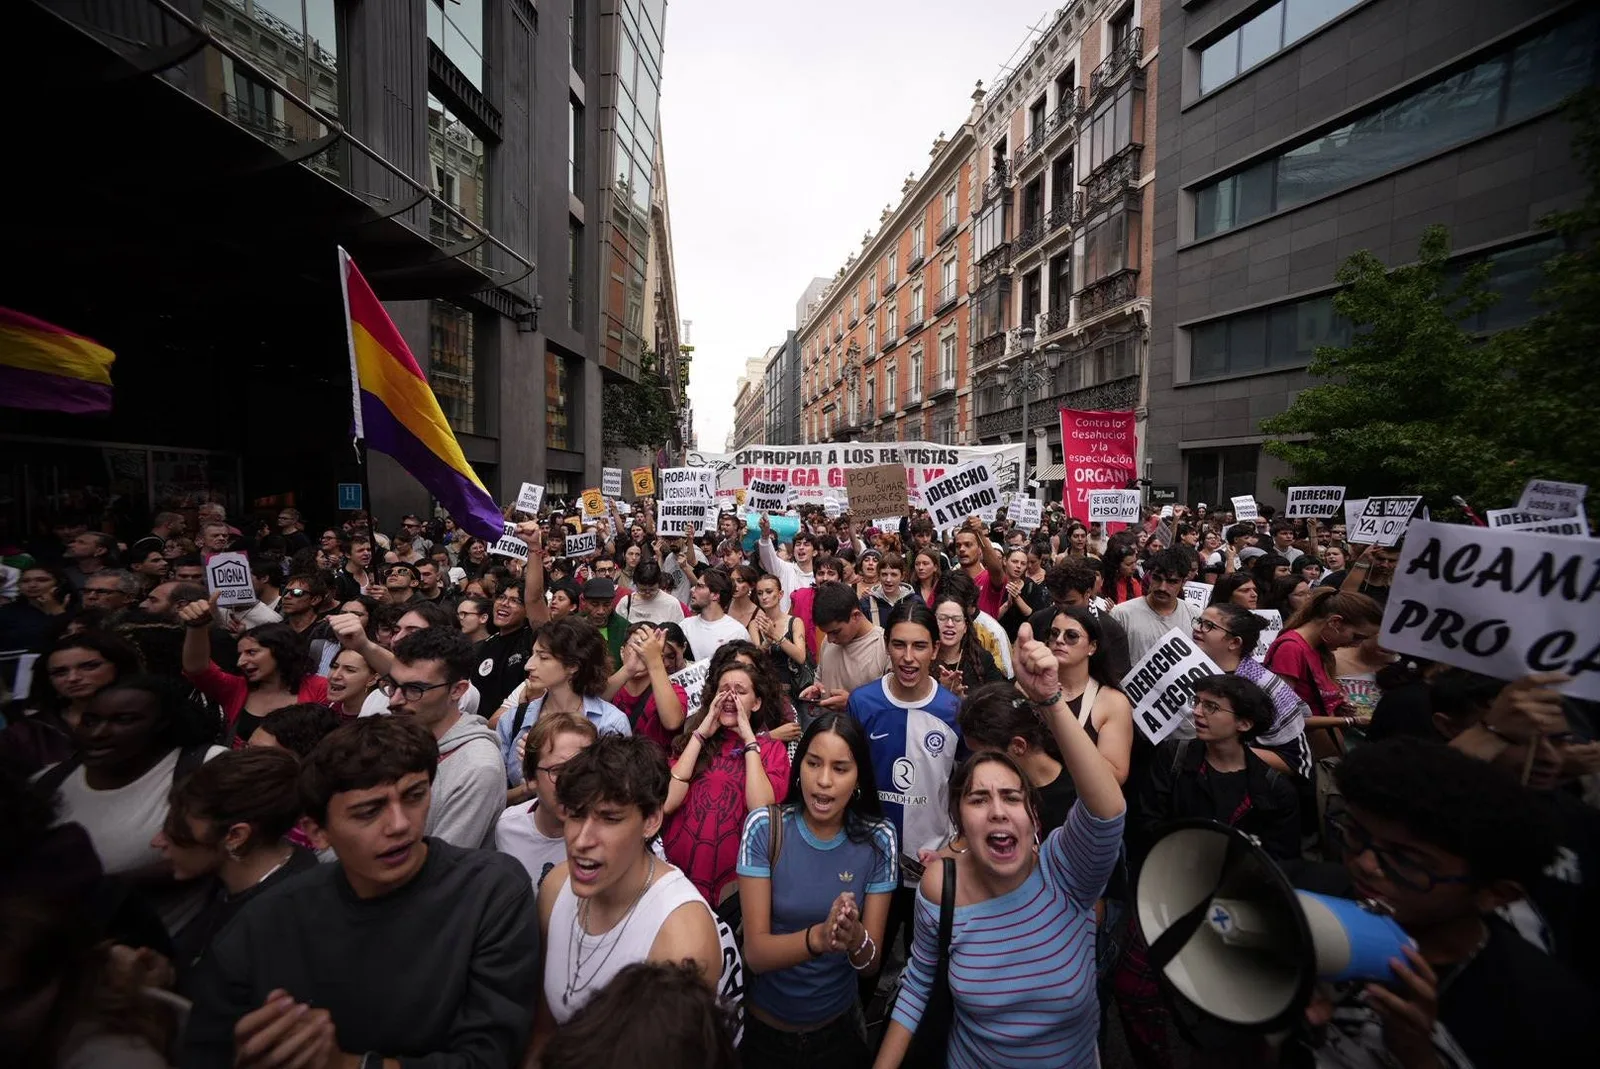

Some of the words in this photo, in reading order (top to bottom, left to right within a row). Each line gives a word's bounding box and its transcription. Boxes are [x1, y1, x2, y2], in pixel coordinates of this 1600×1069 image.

[1076, 418, 1110, 428] Contra
[1112, 419, 1127, 428] los
[1072, 430, 1126, 440] desahucios
[1091, 443, 1097, 452] y
[1099, 442, 1108, 451] la
[736, 450, 822, 465] EXPROPIAR
[828, 450, 837, 464] A
[844, 449, 874, 464] LOS
[1069, 454, 1133, 465] especulación
[664, 472, 697, 483] ROBAN
[1074, 468, 1129, 482] ORGANI
[875, 481, 904, 493] SUMAR
[924, 465, 989, 506] ¡DERECHO
[669, 487, 697, 498] CENSURAN
[1291, 490, 1342, 501] ¡DERECHO
[851, 493, 902, 504] TRAIDORES
[1093, 496, 1101, 504] SE
[1101, 496, 1119, 504] VENDE
[662, 506, 705, 516] ¡DERECHO
[935, 508, 949, 525] A
[945, 487, 998, 519] TECHO!
[1121, 507, 1138, 516] NO!
[1289, 504, 1297, 515] A
[1366, 501, 1382, 515] SE
[662, 520, 668, 531] A
[670, 520, 703, 531] TECO!
[1359, 518, 1377, 535] YA,
[567, 534, 596, 552] BASTA!
[217, 568, 244, 583] DIGNA
[221, 590, 236, 598] RECIO
[1184, 589, 1203, 600] ENDE
[1389, 599, 1511, 657] PRO
[1141, 711, 1163, 733] A
[877, 791, 911, 804] RIYADH
[911, 796, 928, 805] AIR
